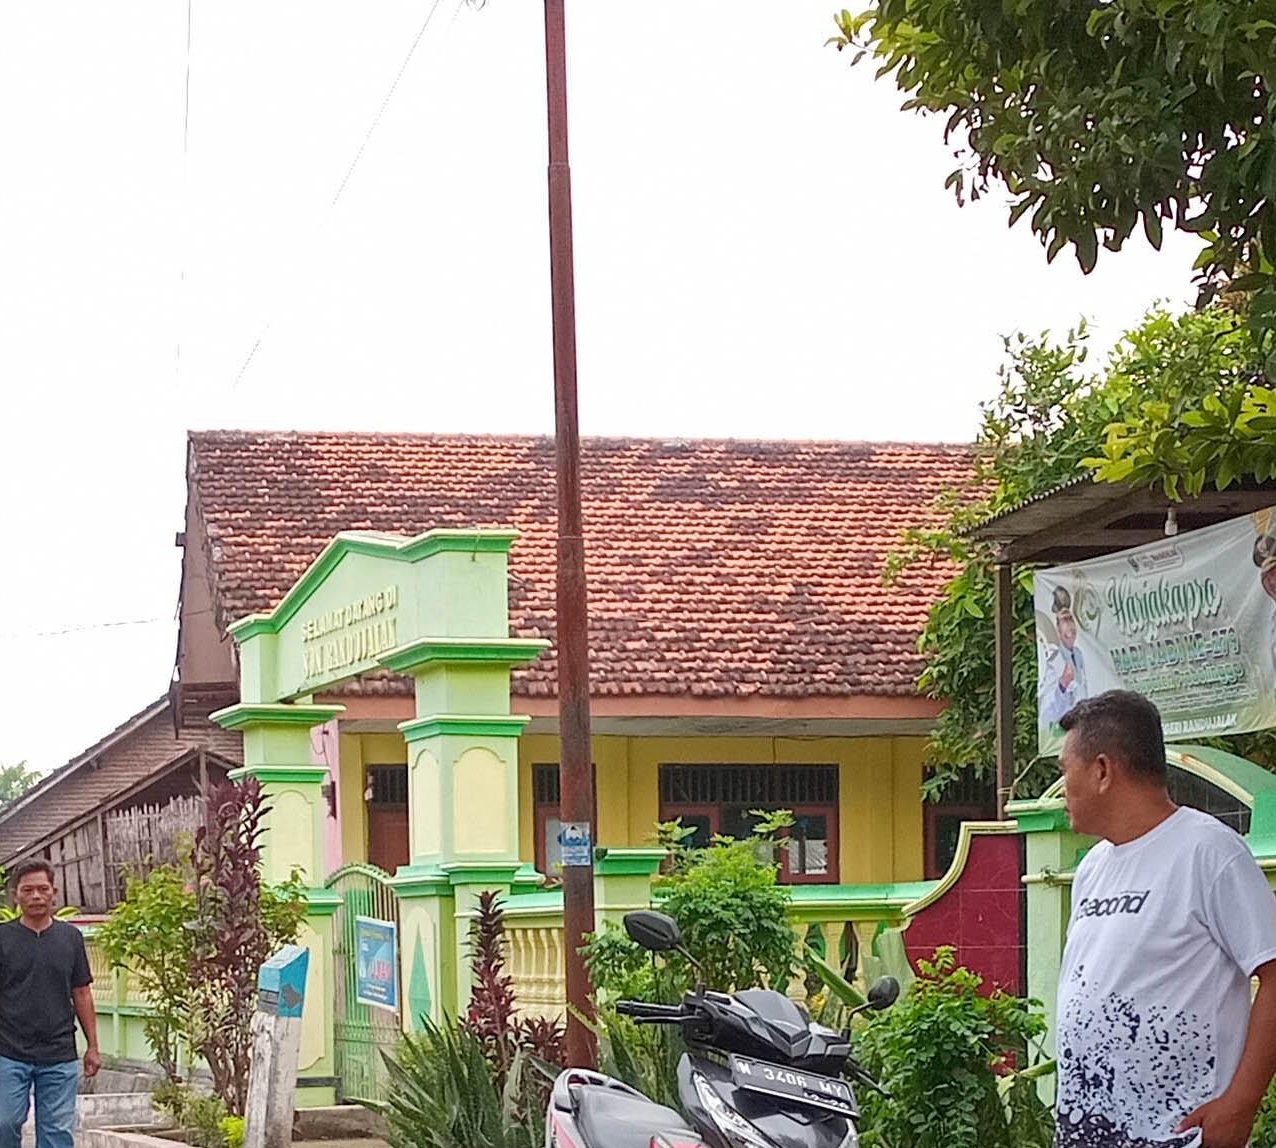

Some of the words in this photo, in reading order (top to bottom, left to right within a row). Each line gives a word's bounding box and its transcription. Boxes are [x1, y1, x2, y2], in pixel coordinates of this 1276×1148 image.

[302, 610, 345, 642] SELAMAT
[346, 591, 385, 626] DATANG
[385, 584, 399, 611] DI
[1110, 644, 1145, 675] HARI
[1147, 632, 1182, 669] JADI
[1182, 712, 1238, 733] RANDUJALAK
[763, 1067, 808, 1088] 3406
